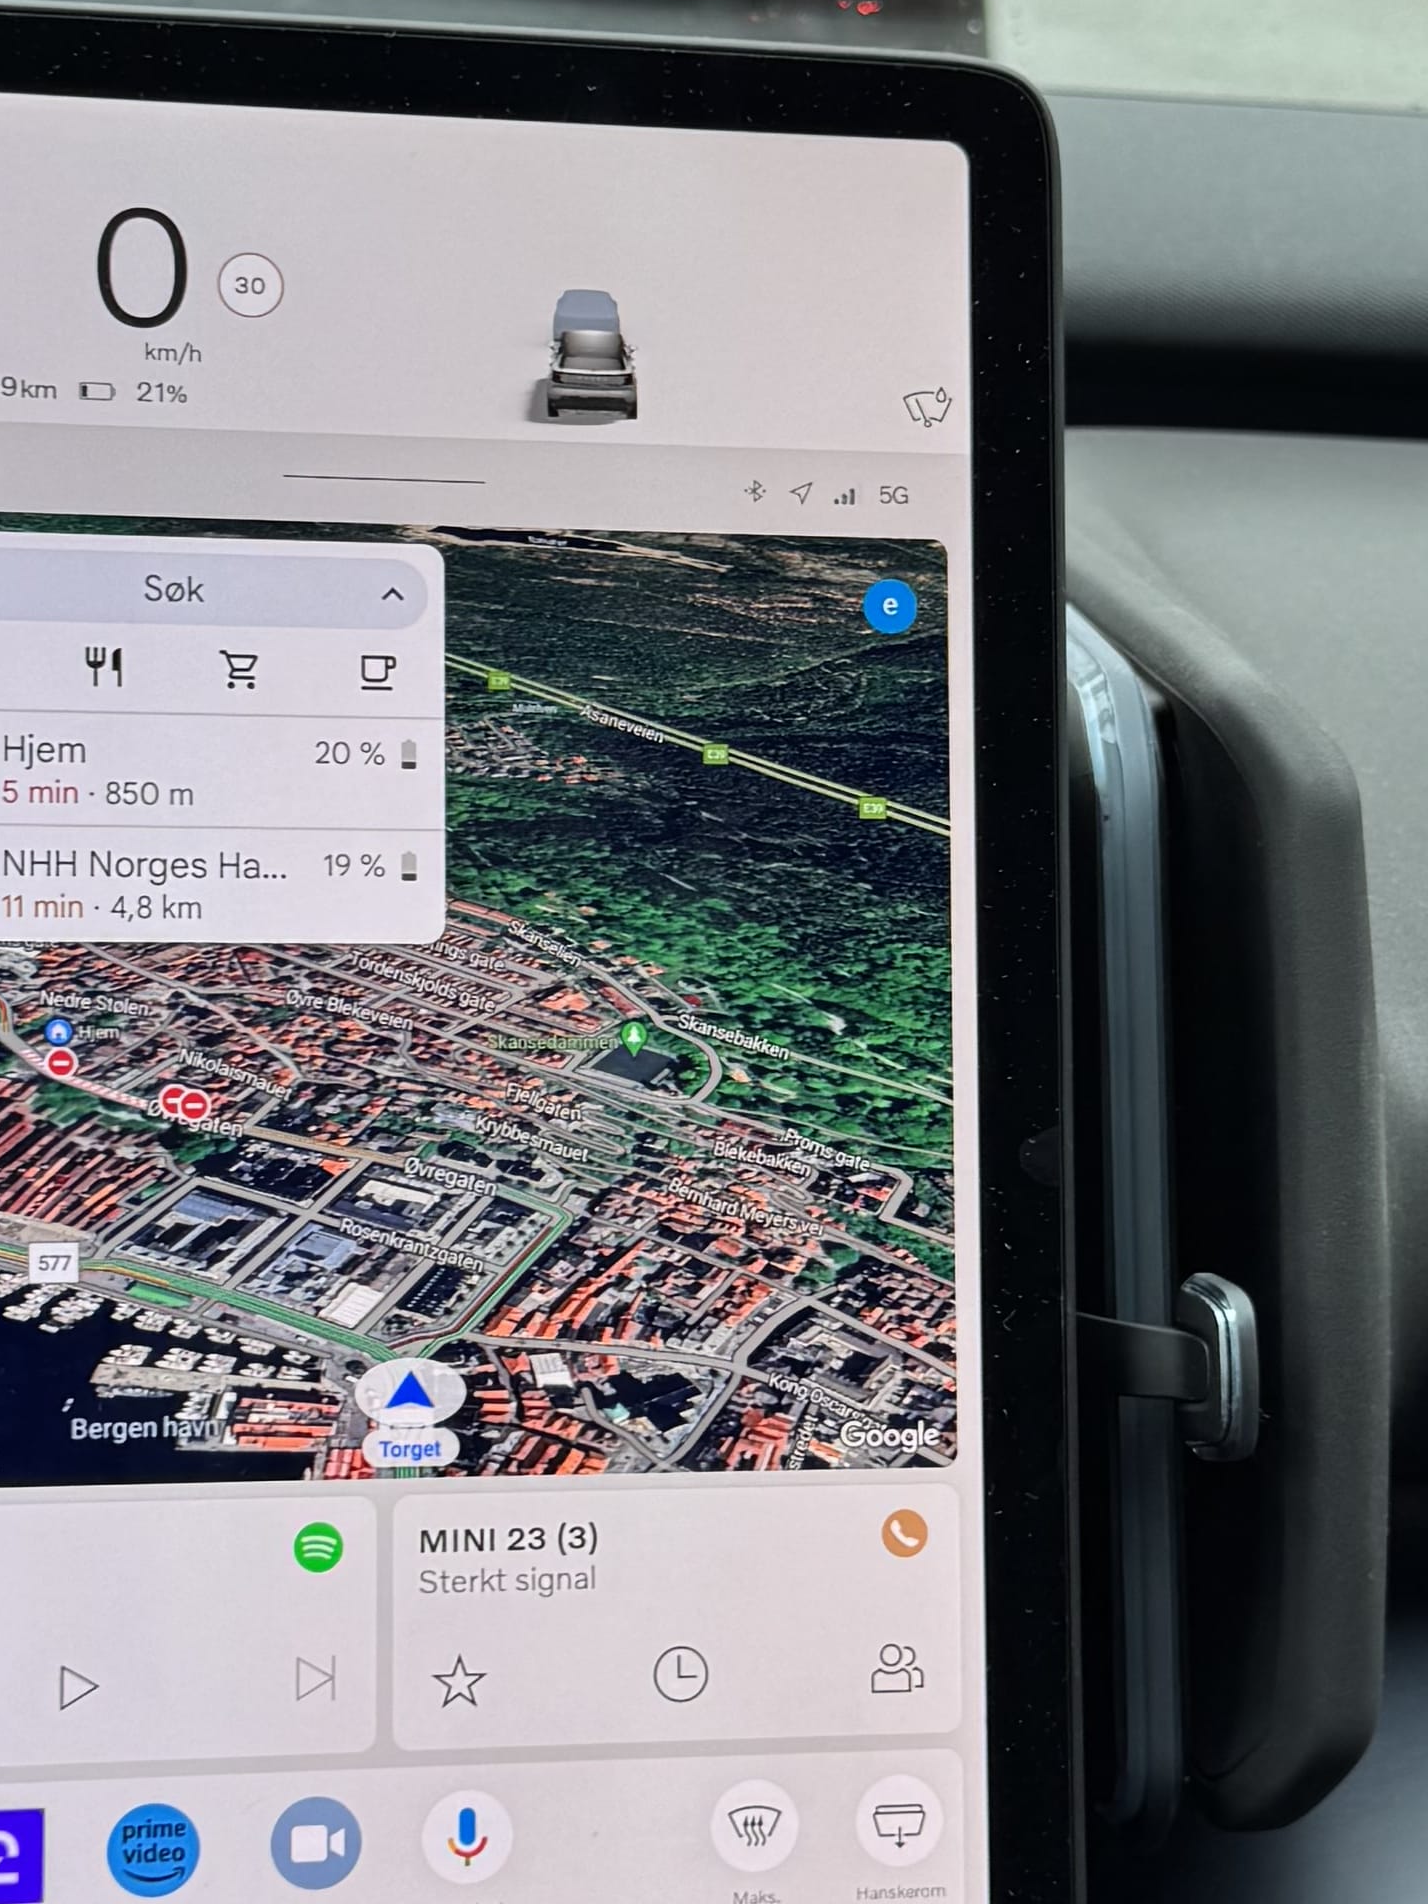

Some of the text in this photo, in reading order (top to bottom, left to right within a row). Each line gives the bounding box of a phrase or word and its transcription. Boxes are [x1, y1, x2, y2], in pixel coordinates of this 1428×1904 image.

[96, 205, 189, 329] 0
[234, 274, 266, 296] 30
[144, 341, 202, 366] km/h
[136, 381, 189, 403] 21%
[878, 484, 910, 506] 5G
[143, 574, 205, 604] Søk
[3, 733, 87, 770] Hjem
[314, 740, 386, 766] 20 %
[1, 778, 194, 806] 5 min 850 m
[3, 849, 77, 877] NHH
[89, 849, 208, 886] Norges
[323, 853, 386, 878] 19 %
[1, 893, 203, 923] 11 min 4,8 km
[348, 949, 497, 1014] Tordenskjolds gate
[39, 990, 151, 1017] Nedre Stølen
[285, 987, 414, 1032] Øvre Blekeveien
[79, 1024, 120, 1043] Hjem
[486, 1033, 620, 1051] Skansedammen
[677, 1013, 791, 1061] Skansebakken
[178, 1048, 294, 1102] Nikolaismauet
[505, 1082, 583, 1122] Fjellgaten
[474, 1114, 589, 1163] Krybbesmauet
[713, 1141, 812, 1178] Blekebakken
[834, 1149, 871, 1172] gate
[403, 1155, 498, 1197] Øvregaten
[668, 1177, 738, 1217] Bernhard
[738, 1203, 801, 1233] Meyers
[338, 1217, 484, 1274] Rosenkrantzgaten
[38, 1254, 72, 1274] 577
[767, 1372, 810, 1403] Kong
[70, 1415, 220, 1446] Bergen havn
[839, 1419, 941, 1455] Google
[378, 1439, 443, 1463] Torget
[418, 1521, 599, 1557] MINI 23 (3)
[418, 1564, 598, 1598] Sterkt signal
[122, 1818, 187, 1844] prime
[122, 1842, 187, 1865] video
